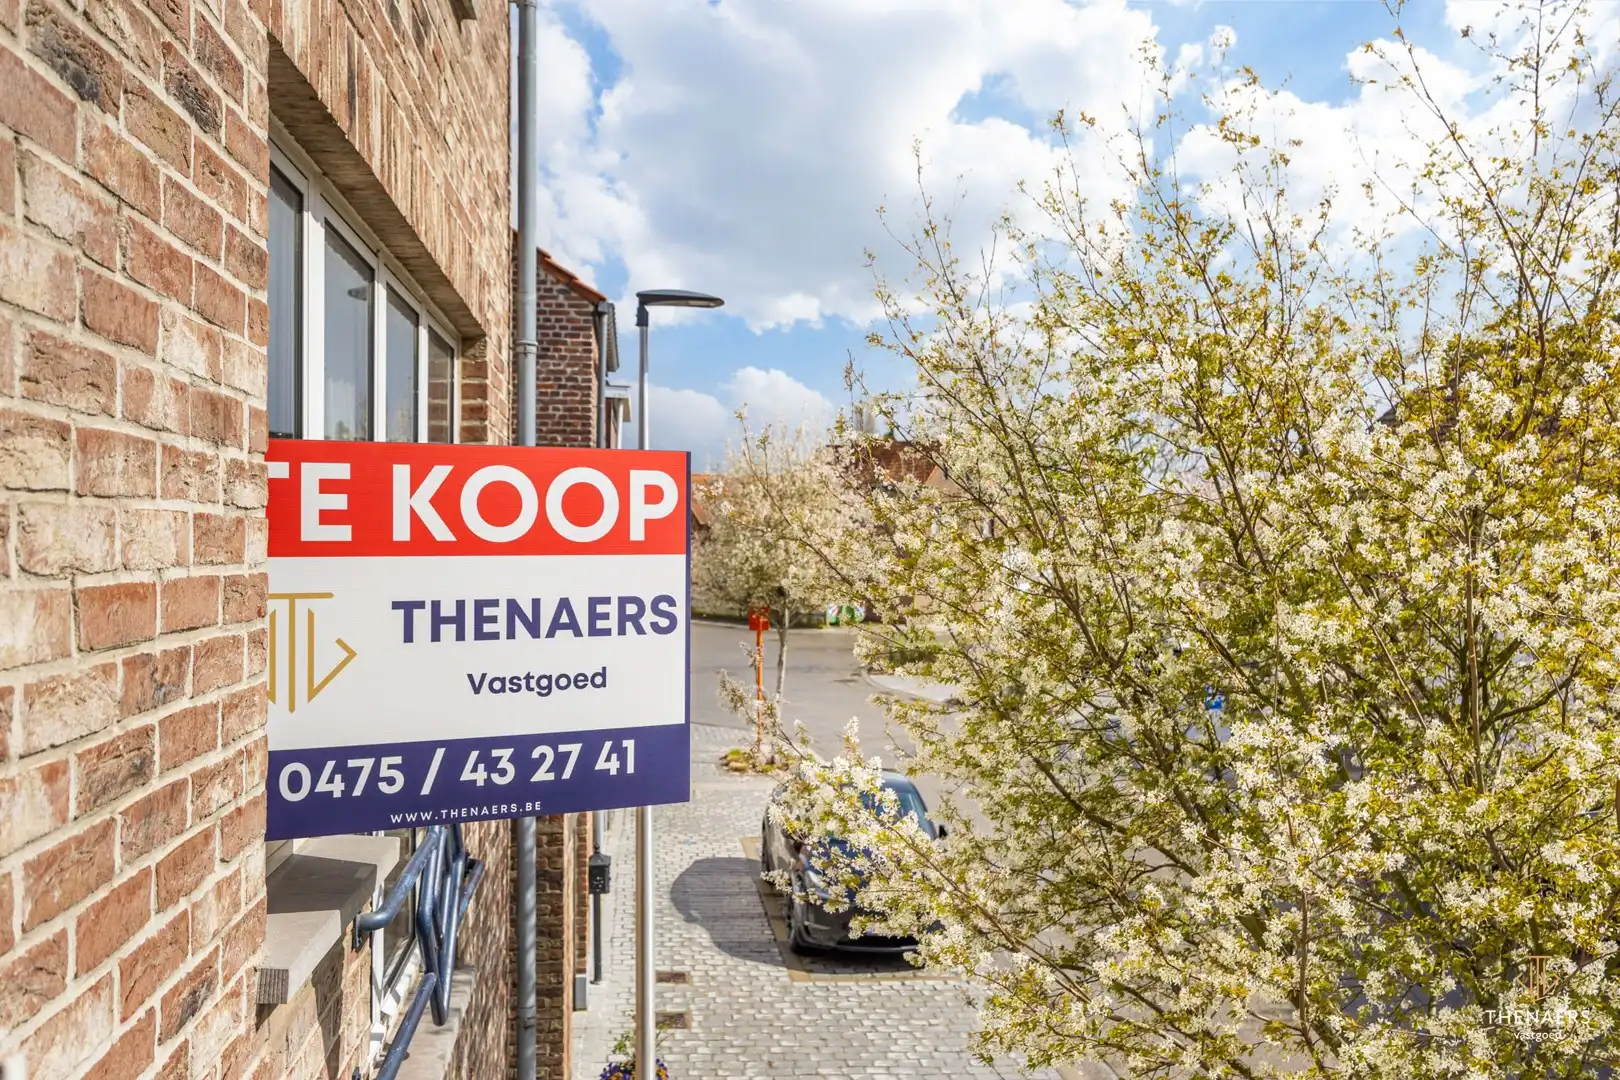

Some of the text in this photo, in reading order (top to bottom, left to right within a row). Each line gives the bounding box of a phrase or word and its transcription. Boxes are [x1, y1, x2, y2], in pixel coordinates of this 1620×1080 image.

[392, 463, 679, 543] KOOP
[391, 594, 678, 644] THENAERS
[466, 666, 608, 698] Vastgoed
[278, 739, 636, 802] 0475 / 43 27 41
[390, 801, 542, 824] WWW.THENAERS.BE
